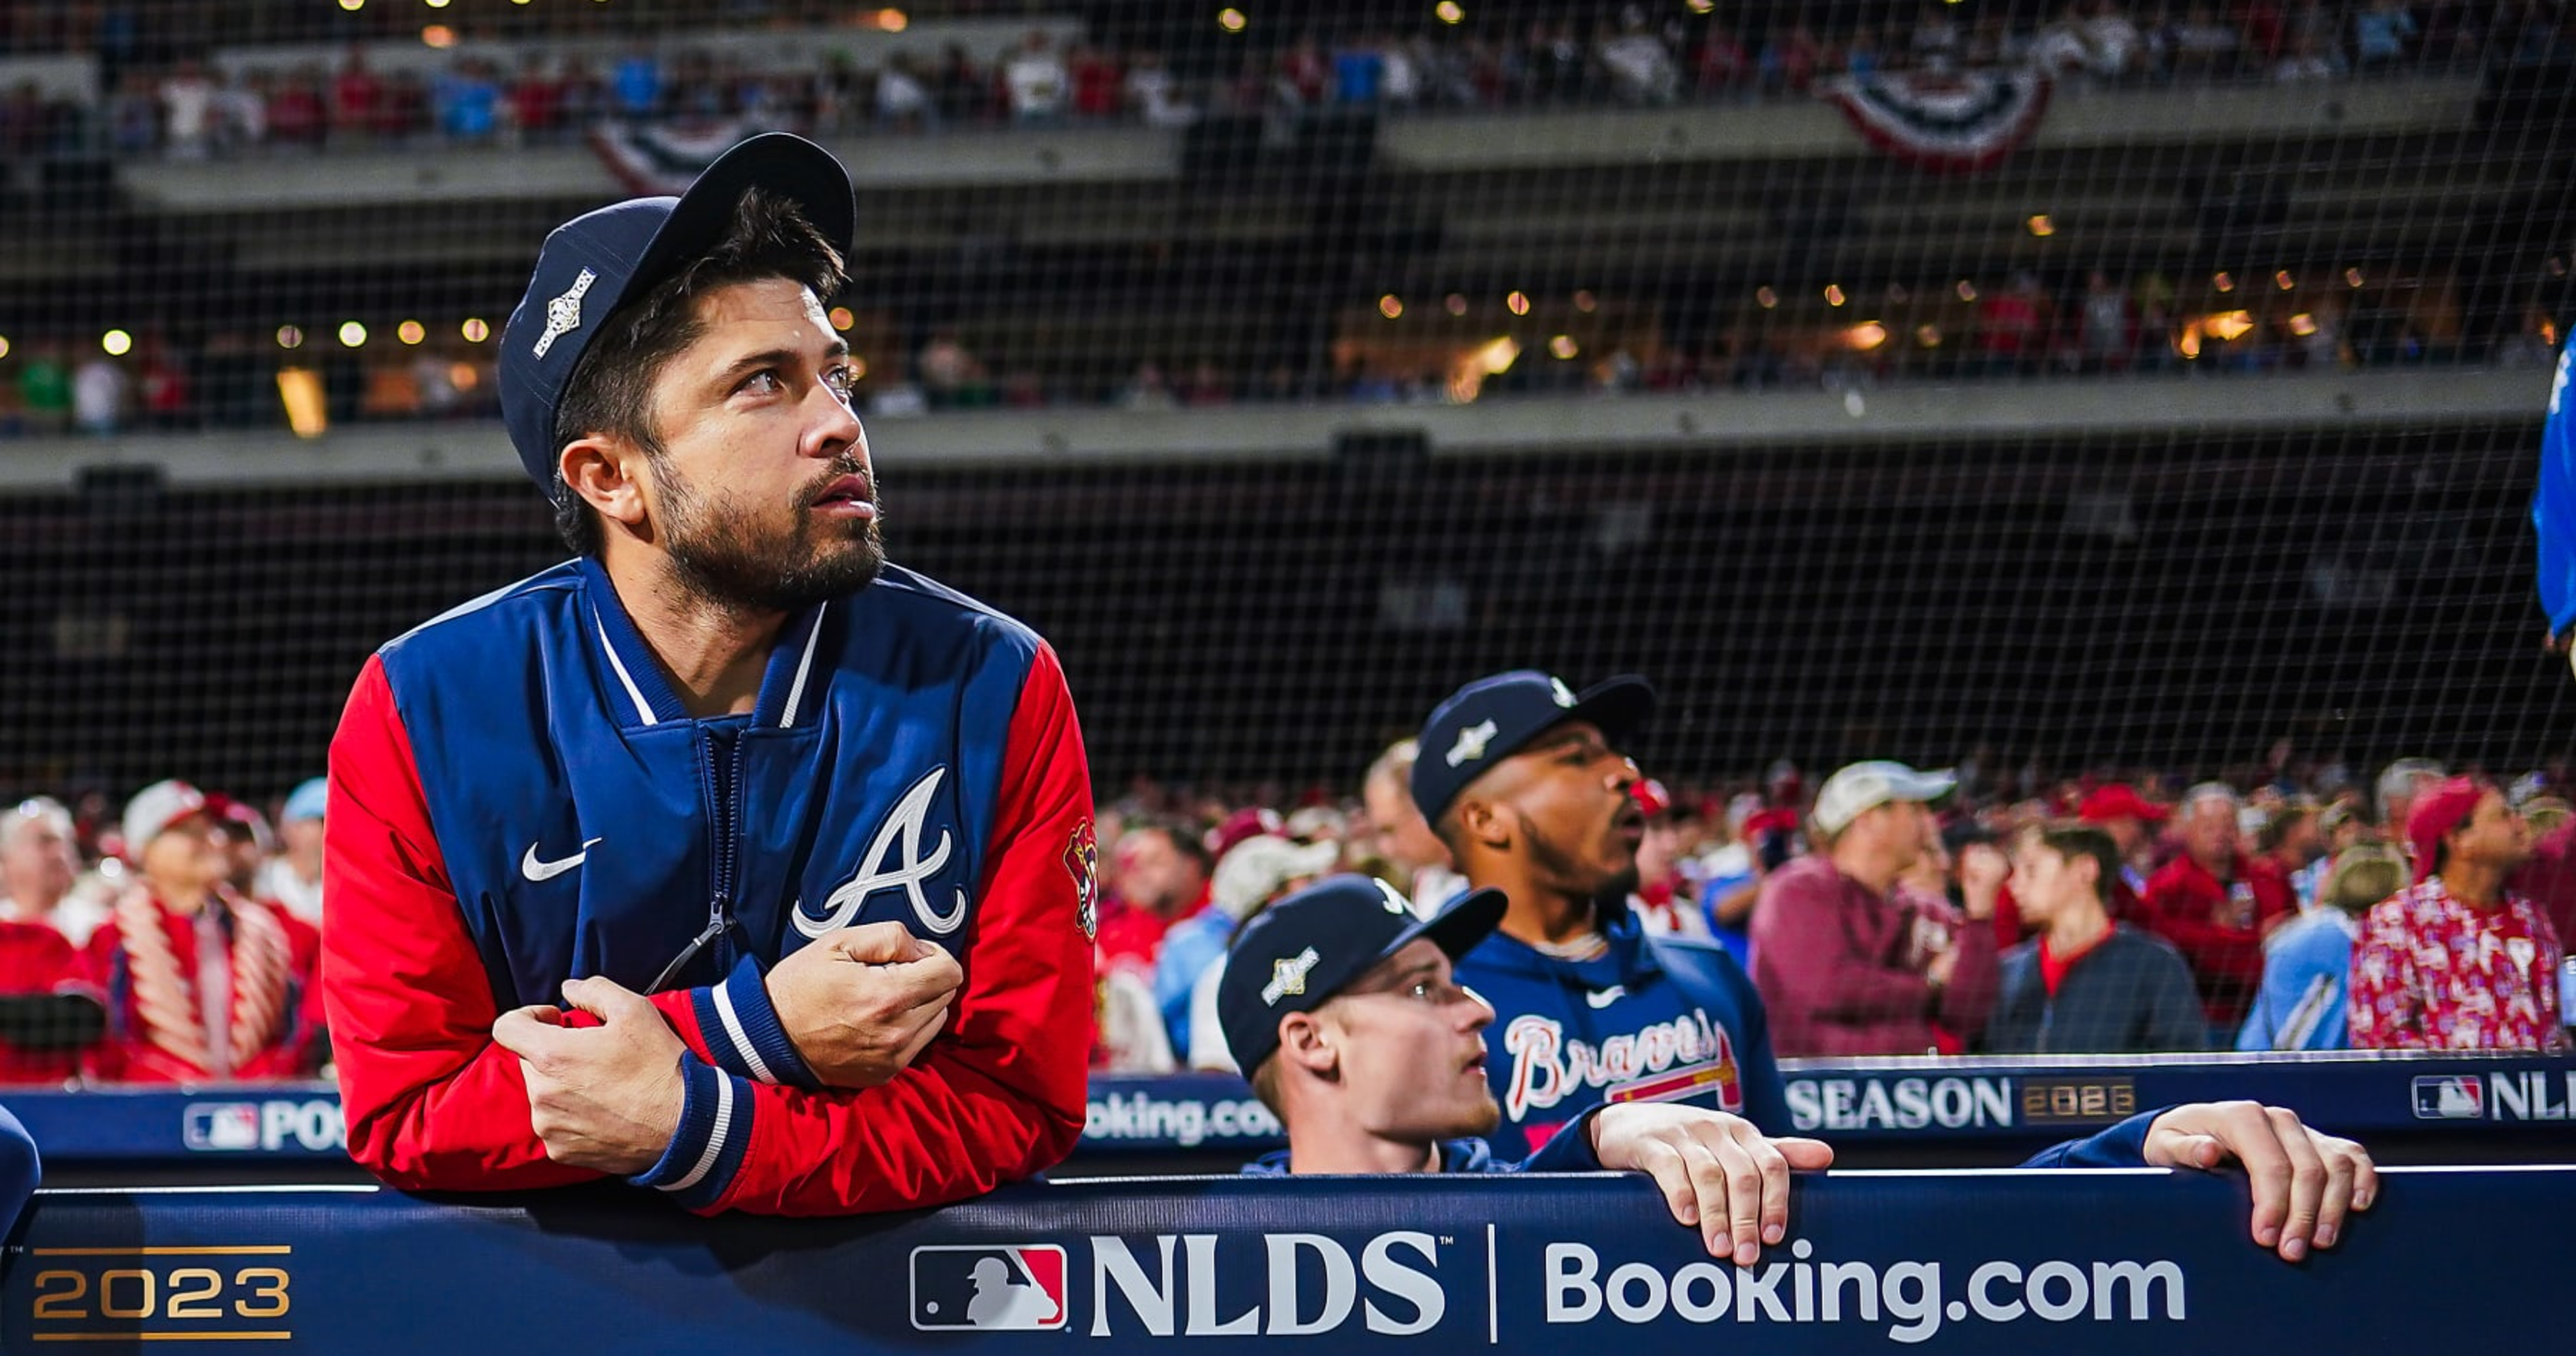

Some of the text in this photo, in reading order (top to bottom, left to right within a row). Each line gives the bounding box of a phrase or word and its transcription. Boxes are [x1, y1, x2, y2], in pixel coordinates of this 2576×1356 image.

[790, 767, 967, 938] A
[1505, 1008, 1718, 1123] Braves
[1085, 1091, 1283, 1146] oking.co
[1784, 1077, 2012, 1131] SEASON
[2489, 1070, 2576, 1120] NL
[33, 1267, 291, 1319] 2023
[1090, 1231, 1446, 1336] NLDS
[1545, 1239, 2186, 1342] Booking.com
